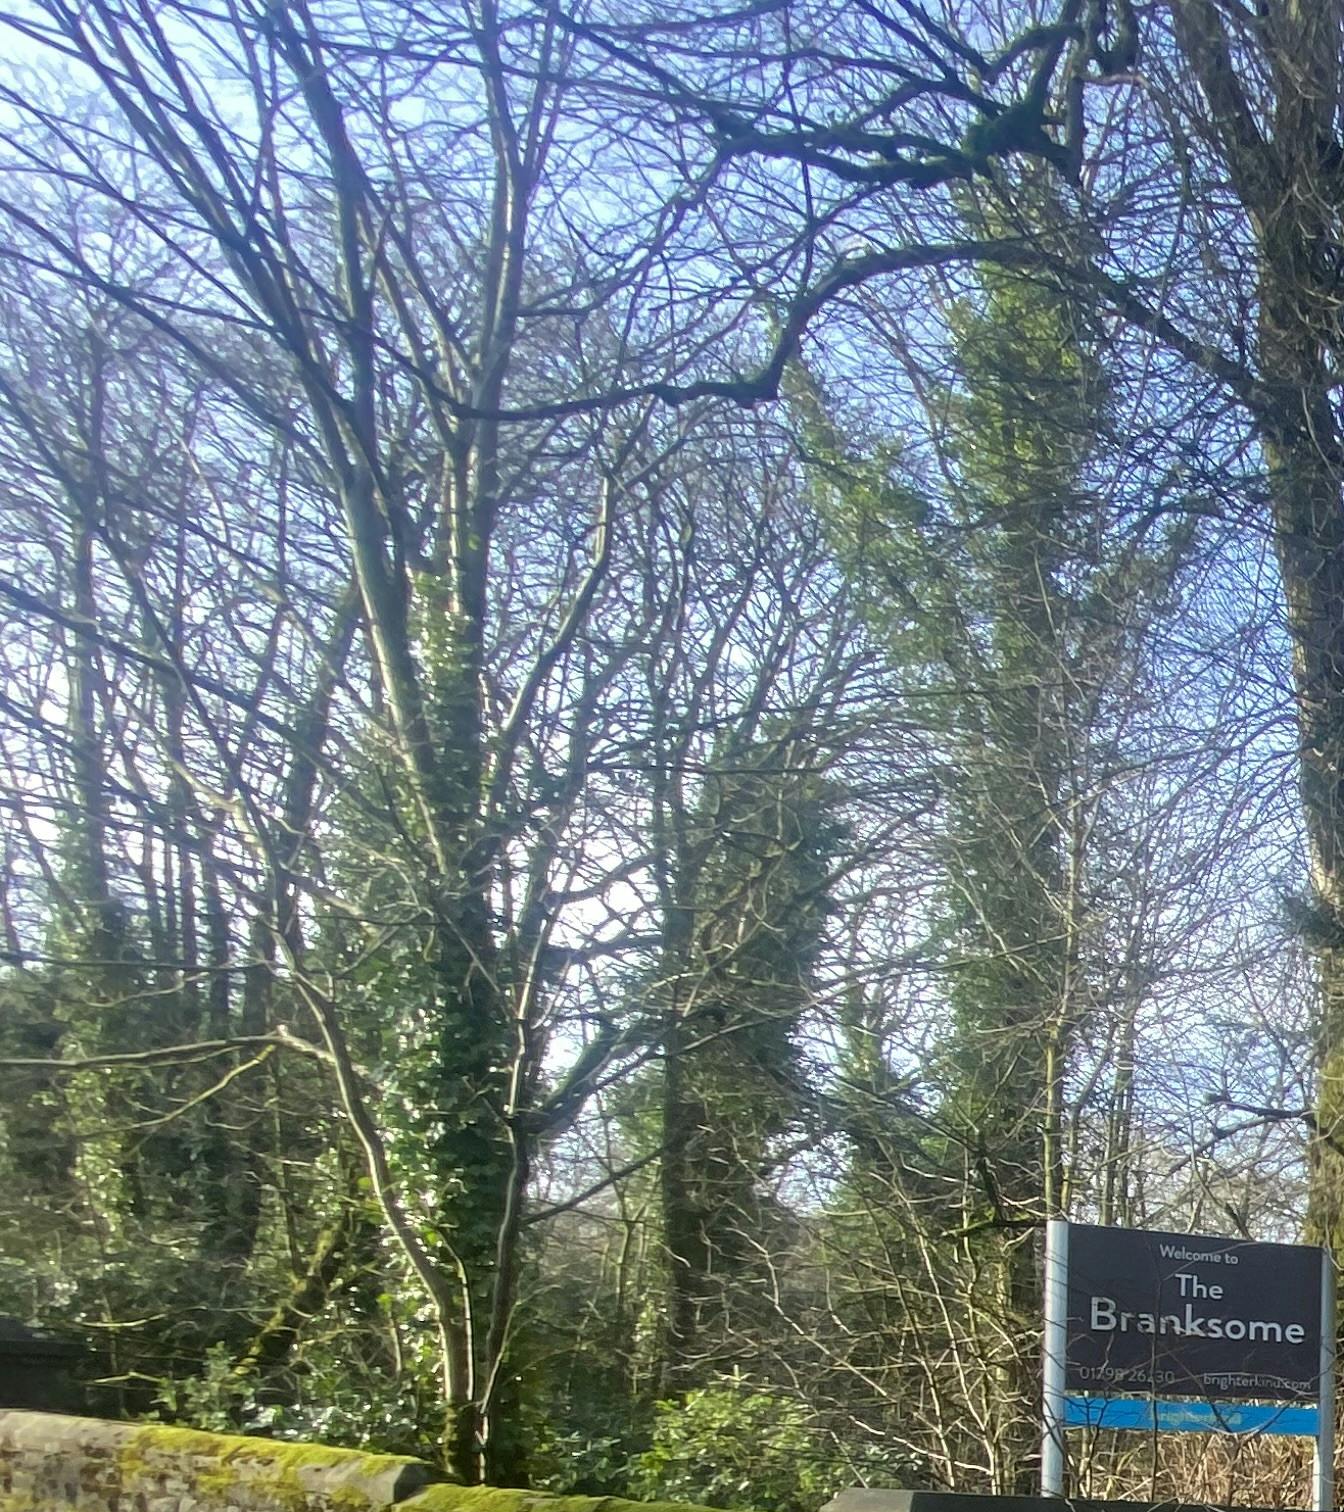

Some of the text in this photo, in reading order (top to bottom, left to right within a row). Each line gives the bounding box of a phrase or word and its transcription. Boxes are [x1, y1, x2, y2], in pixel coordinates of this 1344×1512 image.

[1160, 1244, 1239, 1265] Welcome to
[1175, 1274, 1224, 1300] The
[1090, 1297, 1305, 1344] Branksome
